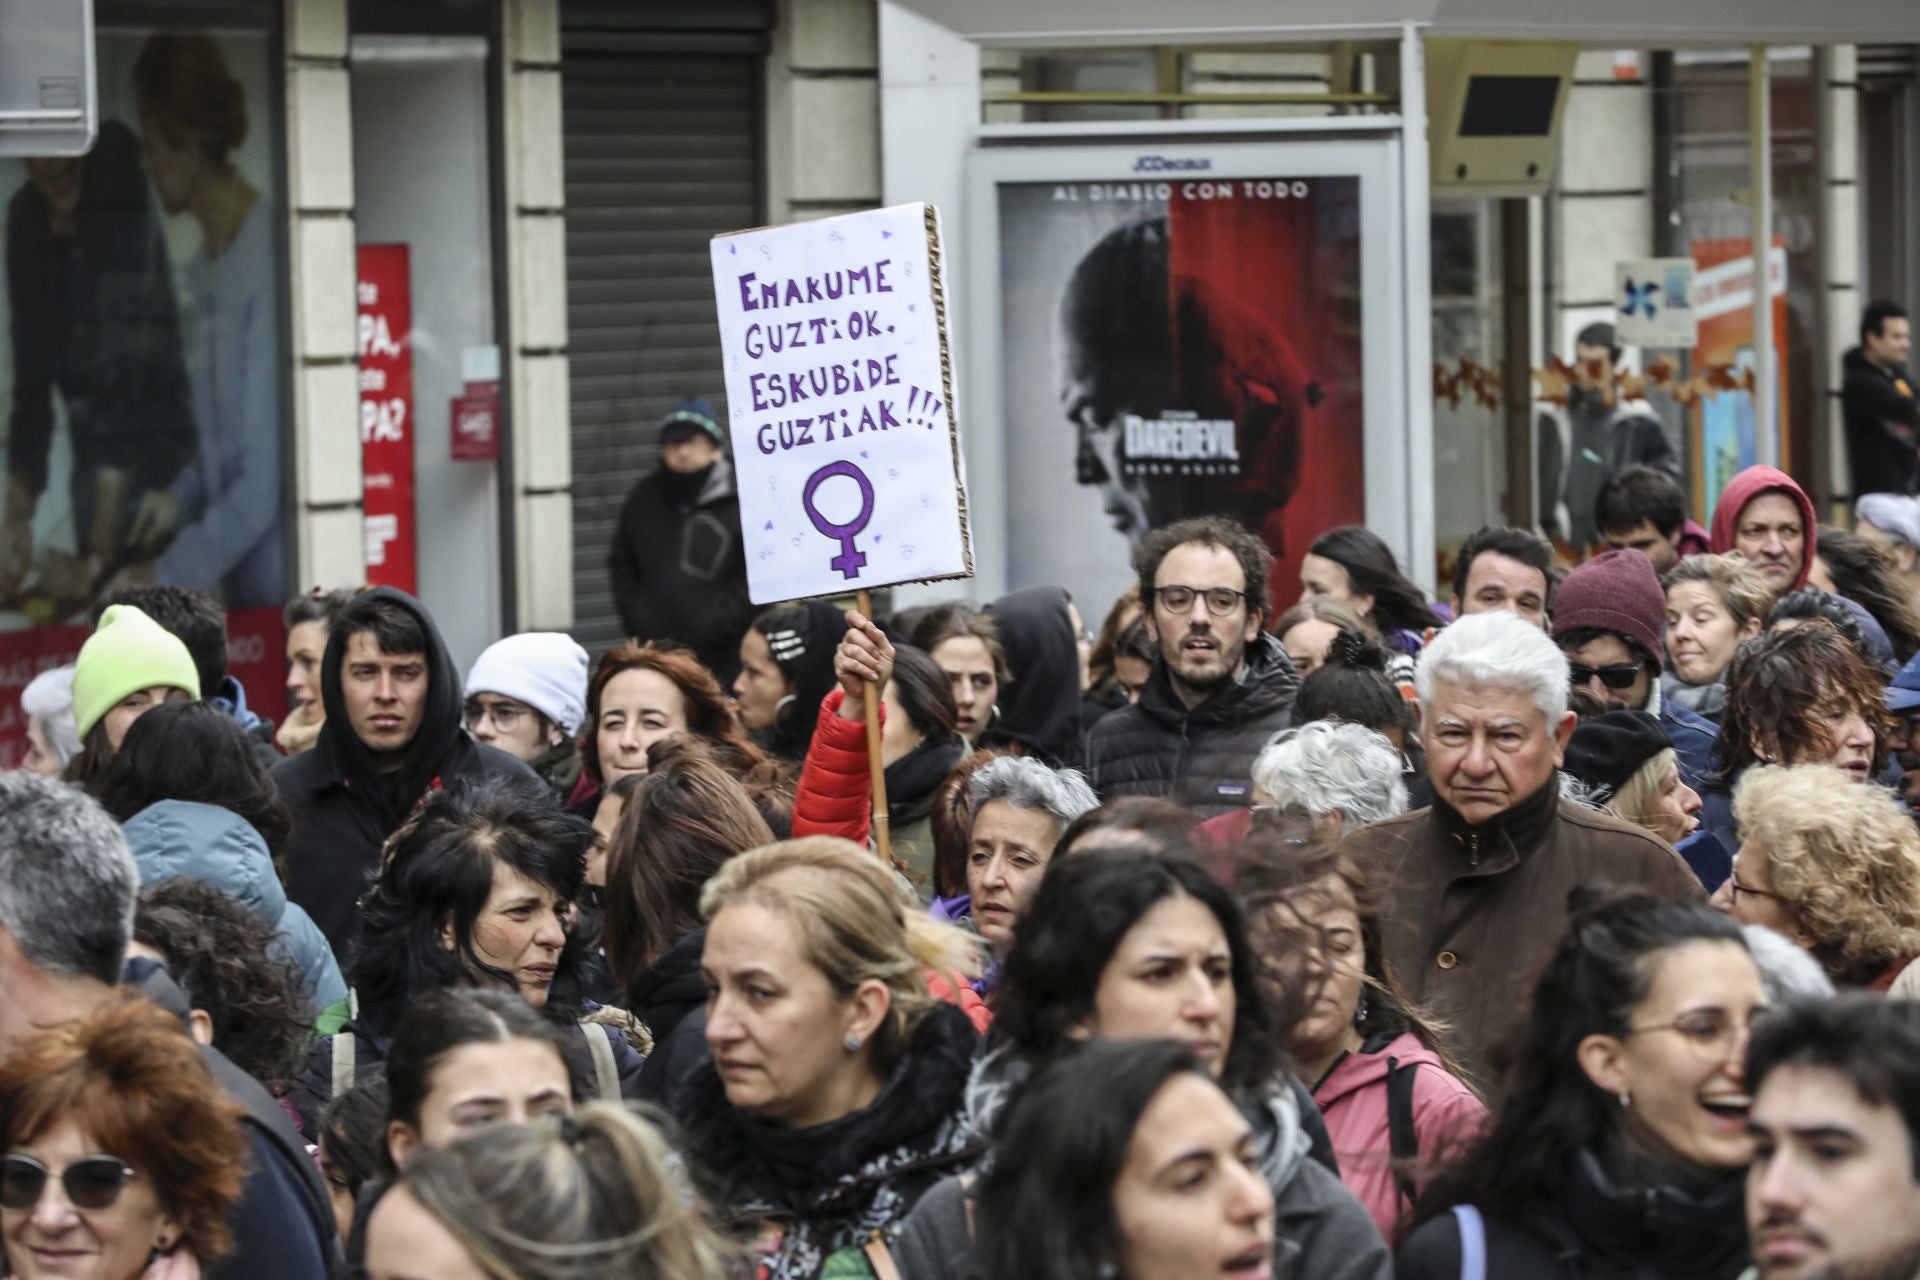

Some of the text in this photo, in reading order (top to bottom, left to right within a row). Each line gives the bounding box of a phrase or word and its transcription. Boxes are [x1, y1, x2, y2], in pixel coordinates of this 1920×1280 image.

[1133, 156, 1212, 172] JCDecaux
[1053, 181, 1309, 202] AL DIABLO CON TODO
[738, 258, 894, 312] EMAKUME
[1124, 414, 1240, 459] DAREDEVIL
